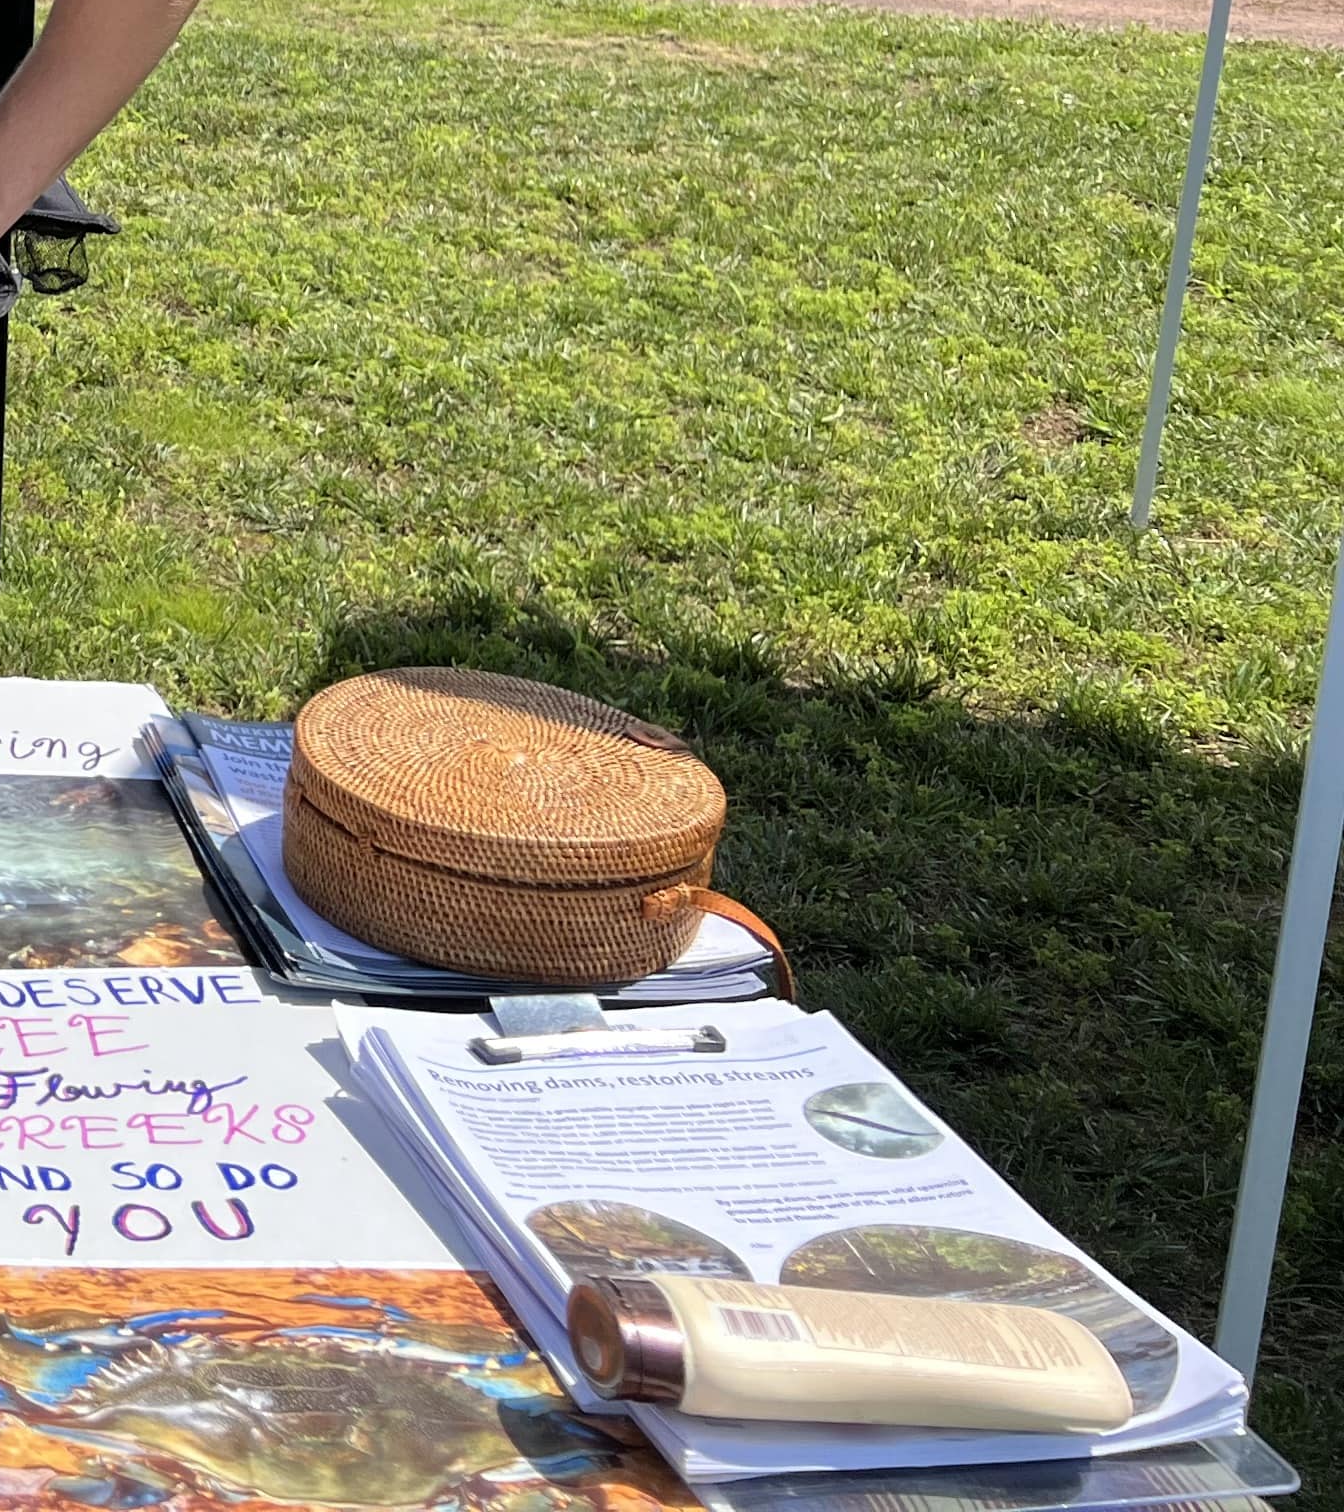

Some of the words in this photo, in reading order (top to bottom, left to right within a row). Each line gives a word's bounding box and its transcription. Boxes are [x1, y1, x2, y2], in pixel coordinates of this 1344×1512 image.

[265, 762, 288, 772] th
[427, 1068, 543, 1095] Removing
[545, 1075, 615, 1091] dams,
[615, 1071, 722, 1089] restoring
[722, 1065, 814, 1081] streams
[112, 1162, 183, 1191] SO
[216, 1162, 298, 1191] DO
[23, 1198, 255, 1255] YOU
